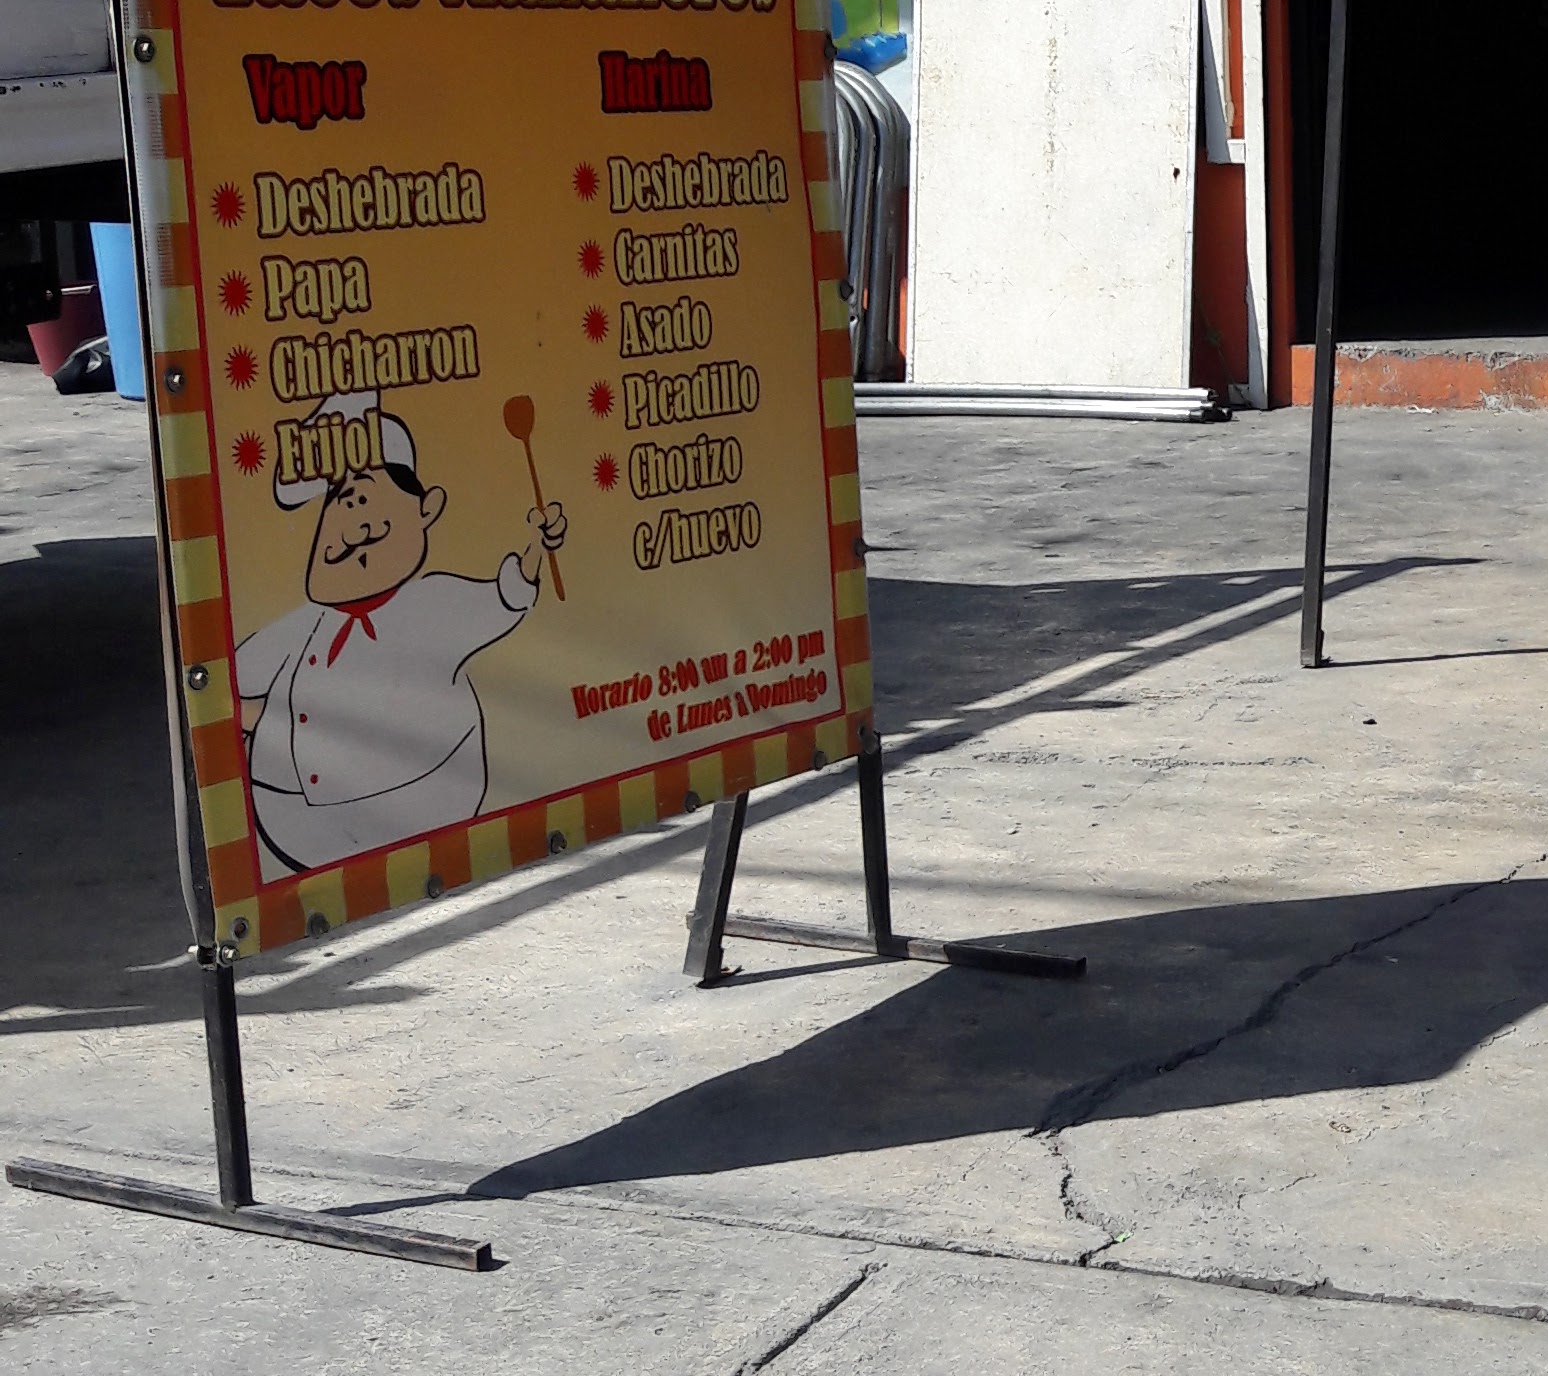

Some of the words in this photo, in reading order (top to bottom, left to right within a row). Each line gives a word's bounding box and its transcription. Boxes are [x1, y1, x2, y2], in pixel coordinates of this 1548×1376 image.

[243, 53, 367, 130] Vapor
[599, 48, 713, 114] Harina
[253, 162, 486, 239] Deshebrada
[607, 149, 788, 214] Deshebrada
[260, 254, 372, 324] Papa
[613, 223, 740, 286] Carnitas
[619, 295, 713, 359] Asado
[270, 323, 481, 403] Chicharron
[622, 359, 760, 430] Picadillo
[274, 407, 385, 485] Frijol
[628, 432, 743, 501] Chorizo
[633, 501, 762, 571] c/huevo
[570, 671, 653, 720] Horario
[658, 657, 699, 697] 8:00
[701, 652, 729, 685] am
[733, 648, 747, 676] a
[751, 633, 793, 673] 2:00
[797, 629, 825, 665] pm
[646, 708, 672, 742] de
[676, 695, 733, 734] Lunes
[734, 690, 749, 717] a
[745, 667, 828, 715] Domingo
